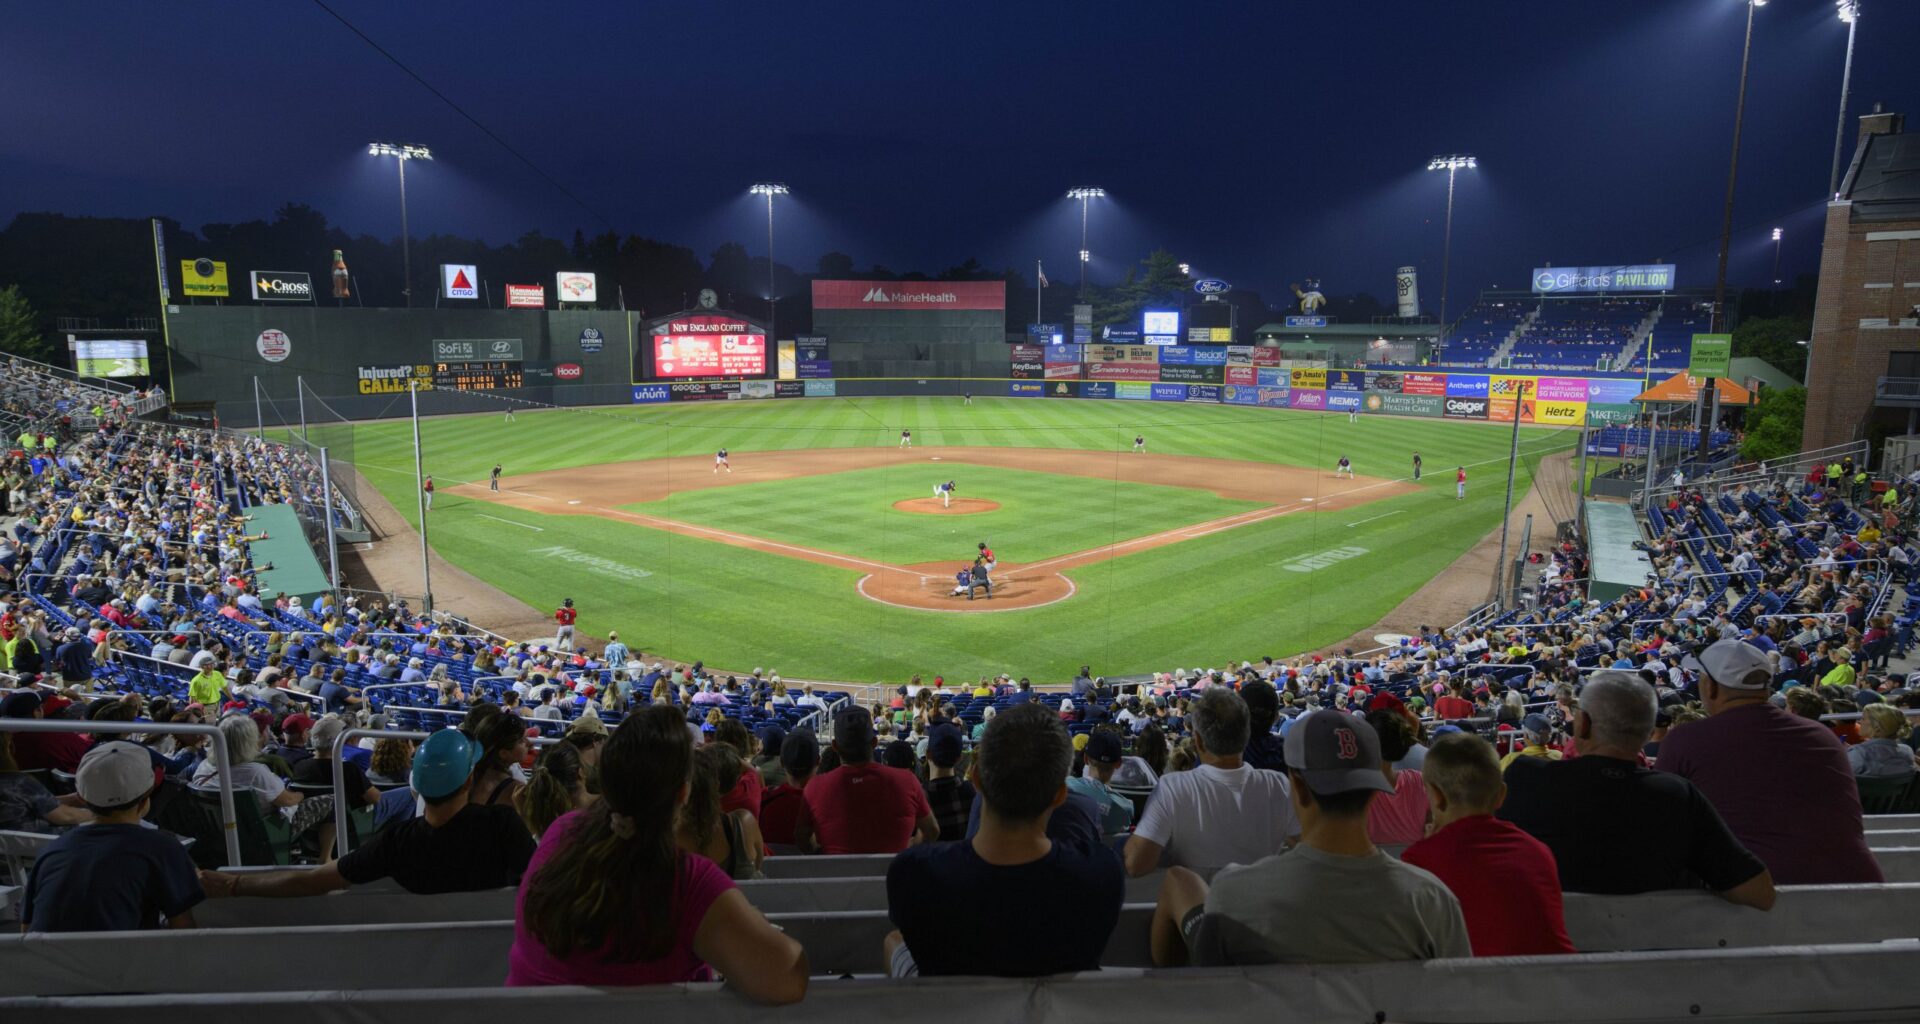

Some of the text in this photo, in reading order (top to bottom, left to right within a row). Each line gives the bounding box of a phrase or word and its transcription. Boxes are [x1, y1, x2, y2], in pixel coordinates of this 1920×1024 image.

[1616, 273, 1668, 287] PAVILION
[272, 279, 309, 292] CROSS
[1200, 281, 1223, 292] Ford
[509, 286, 544, 297] Hammond
[891, 293, 956, 302] MaineHealth
[673, 323, 745, 332] NEW ENGLAND COFFEE
[438, 342, 461, 353] SoFi
[1163, 346, 1188, 354] Bangor
[1194, 349, 1226, 359] bedard
[437, 363, 447, 372] 27
[557, 366, 580, 376] Hood
[1012, 363, 1043, 371] KeyBank
[1129, 367, 1160, 375] Toyota.com
[358, 365, 430, 381] Injured? 50
[1302, 370, 1326, 378] Amato's
[359, 378, 404, 394] CALL
[807, 382, 833, 390] UniFirst
[1506, 378, 1535, 392] VIP
[634, 387, 666, 399] unum
[1328, 396, 1360, 406] MEMIC
[1384, 396, 1438, 406] MARTIN'S POINT
[1446, 399, 1485, 413] Geiger
[1384, 403, 1431, 413] HEALTH CARE
[1545, 406, 1576, 417] Hertz
[1590, 410, 1635, 421] M&T Bank
[1333, 727, 1359, 760] B
